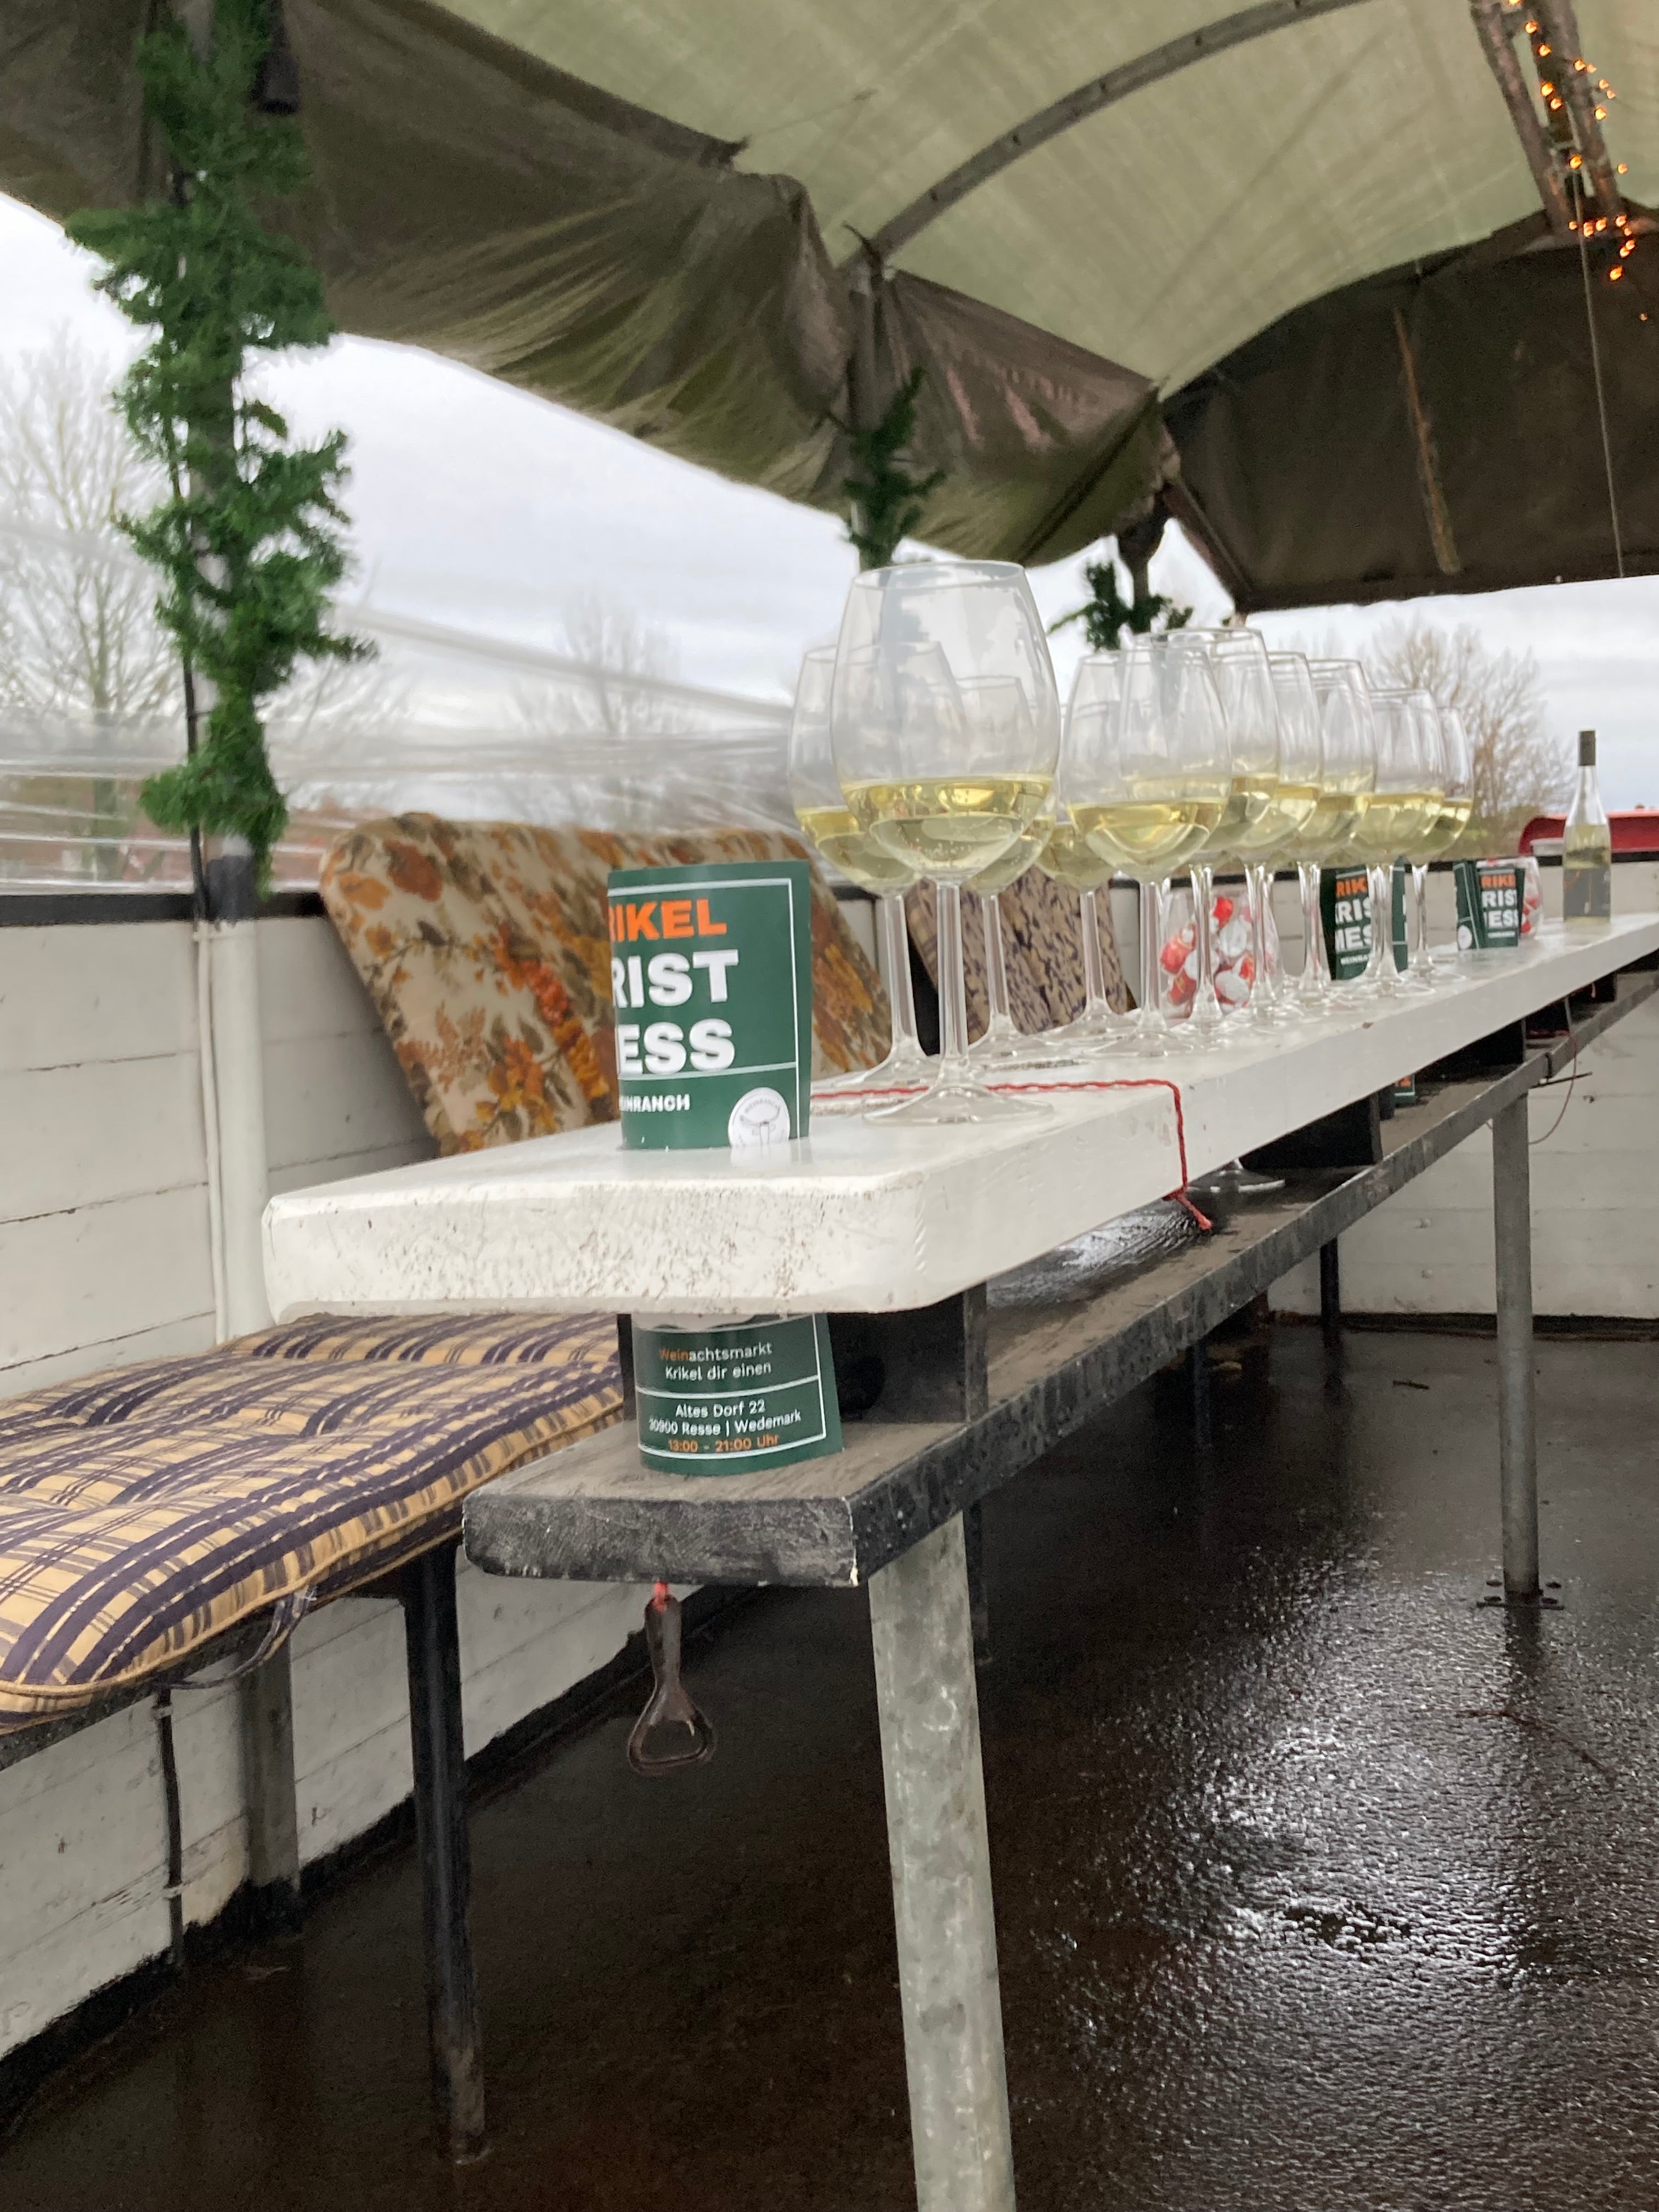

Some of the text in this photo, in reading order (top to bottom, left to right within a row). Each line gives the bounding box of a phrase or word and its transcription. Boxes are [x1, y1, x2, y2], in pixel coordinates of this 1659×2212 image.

[1336, 877, 1368, 898] RIK
[616, 1018, 735, 1075] ESS
[659, 1342, 772, 1362] Weinachtsmarkt
[665, 1362, 771, 1381] Krikel dir einen
[675, 1399, 766, 1418] Altes Dorf 22
[682, 1421, 721, 1436] Resse
[734, 1409, 802, 1434] Wedemark
[668, 1439, 698, 1453] 13:00
[715, 1437, 752, 1453] 21:00
[757, 1434, 780, 1448] Uhr
